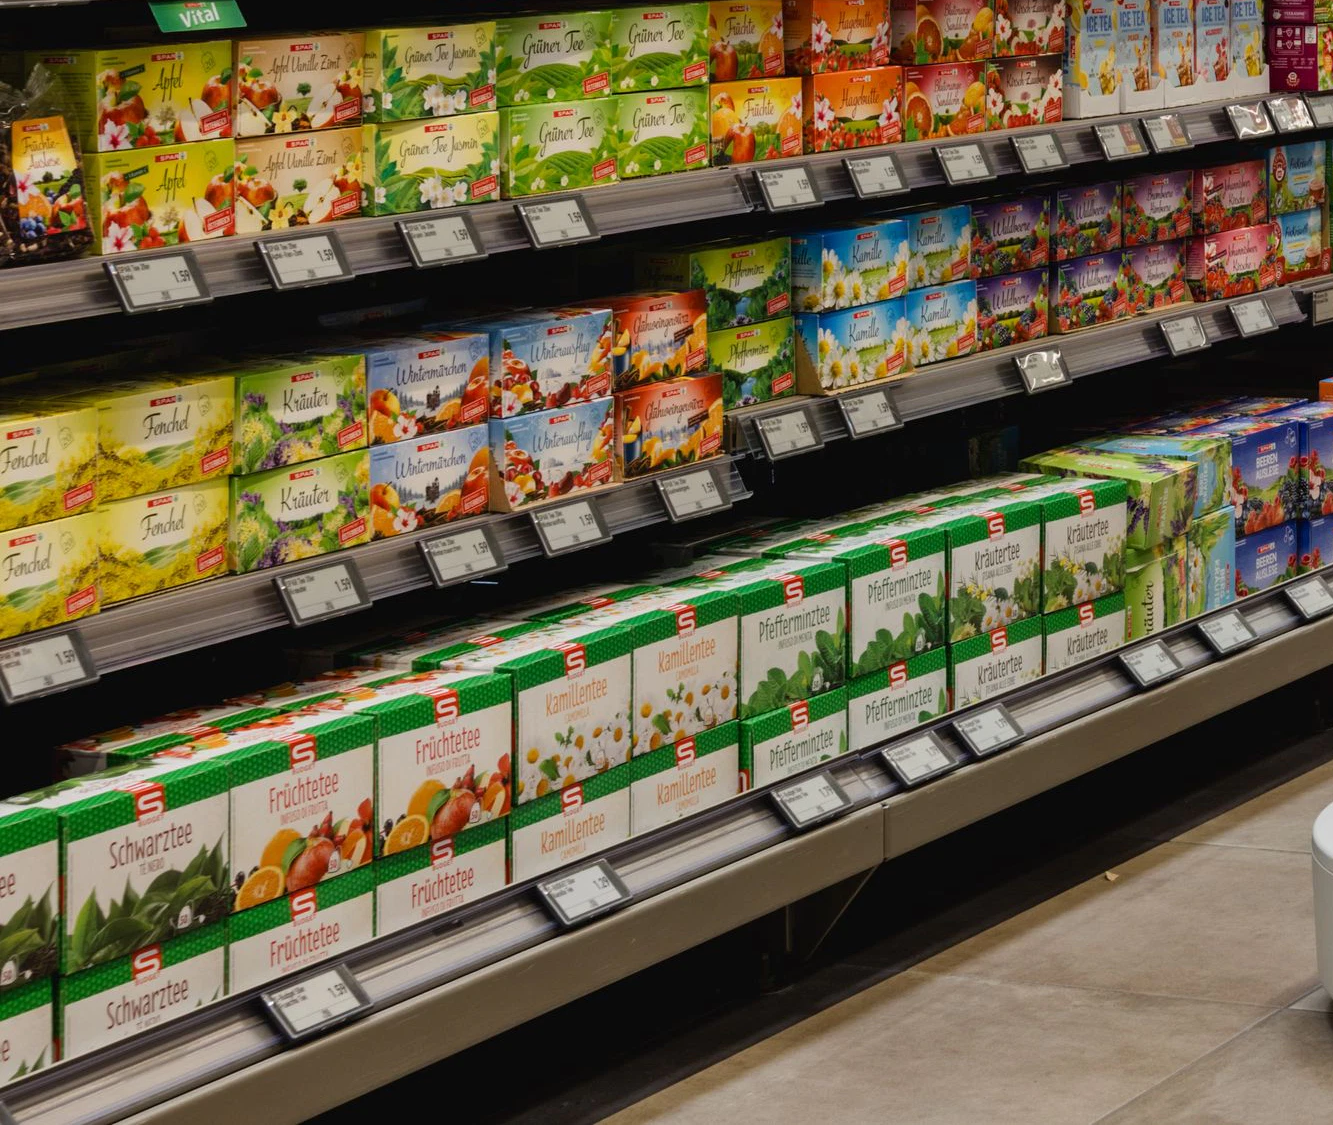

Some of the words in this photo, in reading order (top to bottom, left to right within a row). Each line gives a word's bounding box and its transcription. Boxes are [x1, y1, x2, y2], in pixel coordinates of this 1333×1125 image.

[179, 3, 220, 28] Vital
[1086, 14, 1098, 32] ICE
[1098, 14, 1112, 32] TEA
[1119, 10, 1131, 27] ICE
[1131, 9, 1145, 26] TEA
[522, 33, 561, 69] Grüner
[564, 29, 585, 52] Tee
[628, 24, 664, 57] Grüner
[667, 20, 686, 41] Tee
[268, 55, 289, 82] Apfel
[291, 53, 319, 73] Vanille
[320, 55, 342, 71] Zimt
[405, 47, 432, 74] Grüner
[435, 43, 449, 61] Tee
[449, 46, 477, 70] Jasmin
[153, 64, 183, 102] Apfel
[400, 139, 430, 168] Grüner
[432, 135, 448, 154] Tee
[448, 137, 478, 162] Jasmin
[157, 163, 186, 203] Apfel
[852, 241, 882, 264] Kamille
[172, 269, 192, 284] 1.59
[849, 319, 880, 342] Kamille
[397, 356, 467, 386] Wintermärchen
[283, 387, 331, 413] Kräuter
[143, 405, 191, 440] Fenchel
[1, 439, 50, 473] Fenchel
[396, 447, 467, 480] Wintermärchen
[281, 485, 331, 513] Kräuter
[141, 505, 186, 540] Fenchel
[1066, 519, 1109, 545] Kräutertee
[2, 543, 52, 581] Fenchel
[974, 542, 1020, 571] Kräutertee
[334, 578, 352, 593] 1.59
[867, 568, 932, 605] Pfefferminztee
[759, 604, 831, 643] Pfefferminztee
[54, 650, 76, 665] 1.59
[658, 636, 716, 674] Kamillentee
[1067, 628, 1108, 657] Kräutertee
[977, 654, 1023, 686] Kräutertee
[546, 677, 608, 717] Kamillentee
[865, 686, 933, 725] Pfefferminztee
[416, 727, 480, 765] Früchtetee
[770, 728, 834, 771] Pfefferminztee
[269, 772, 339, 814] Früchtetee
[657, 767, 717, 806] Kamillentee
[109, 822, 193, 869] Schwarztee
[540, 812, 605, 855] Kamillentee
[411, 866, 474, 909] Früchtetee
[270, 922, 340, 967] Früchtetee
[106, 978, 189, 1029] Schwarztee
